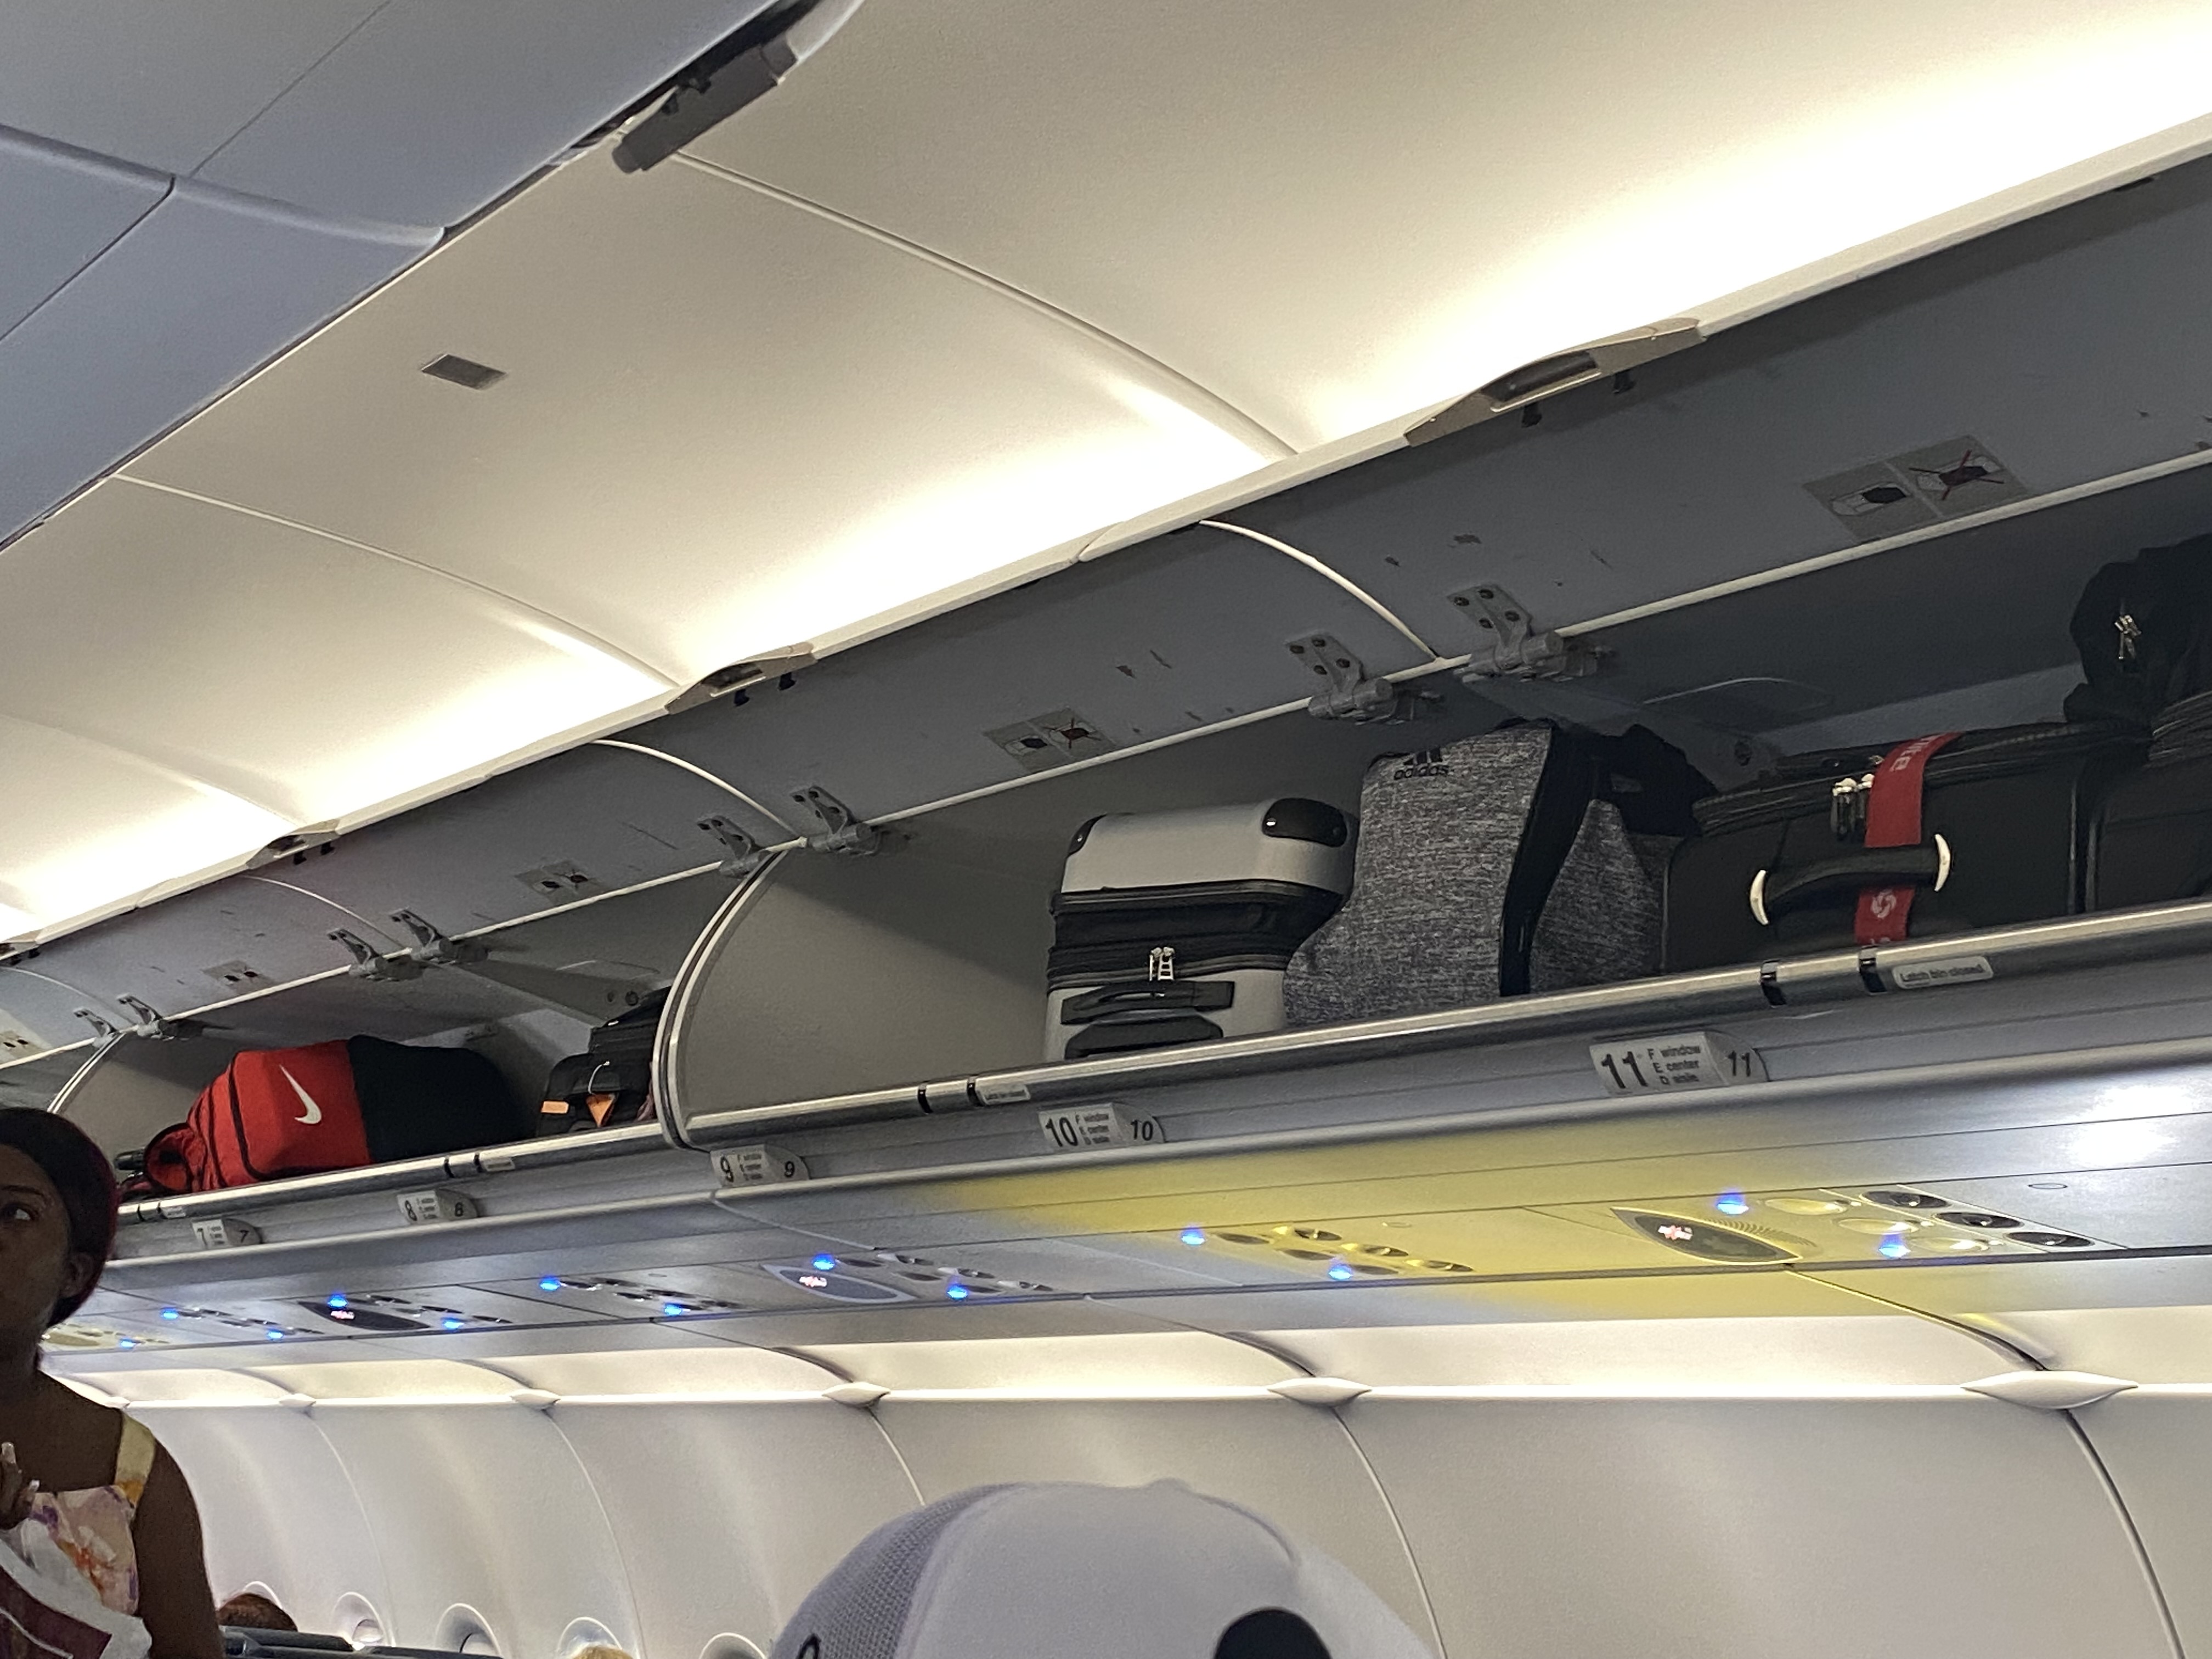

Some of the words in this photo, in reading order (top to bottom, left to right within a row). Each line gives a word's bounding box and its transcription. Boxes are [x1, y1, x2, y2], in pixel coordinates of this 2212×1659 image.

[1647, 1048, 1655, 1060] F
[1660, 1044, 1701, 1058] window
[1600, 1051, 1649, 1090] 11
[1654, 1062, 1663, 1073] E
[1667, 1059, 1700, 1071] center
[1726, 1051, 1751, 1077] 11
[1045, 1116, 1079, 1147] 10
[1130, 1119, 1154, 1142] 10
[720, 1155, 734, 1183] 9
[783, 1161, 795, 1178] 9
[404, 1200, 417, 1222] 8
[454, 1201, 464, 1217] 8
[239, 1229, 250, 1243] 7
